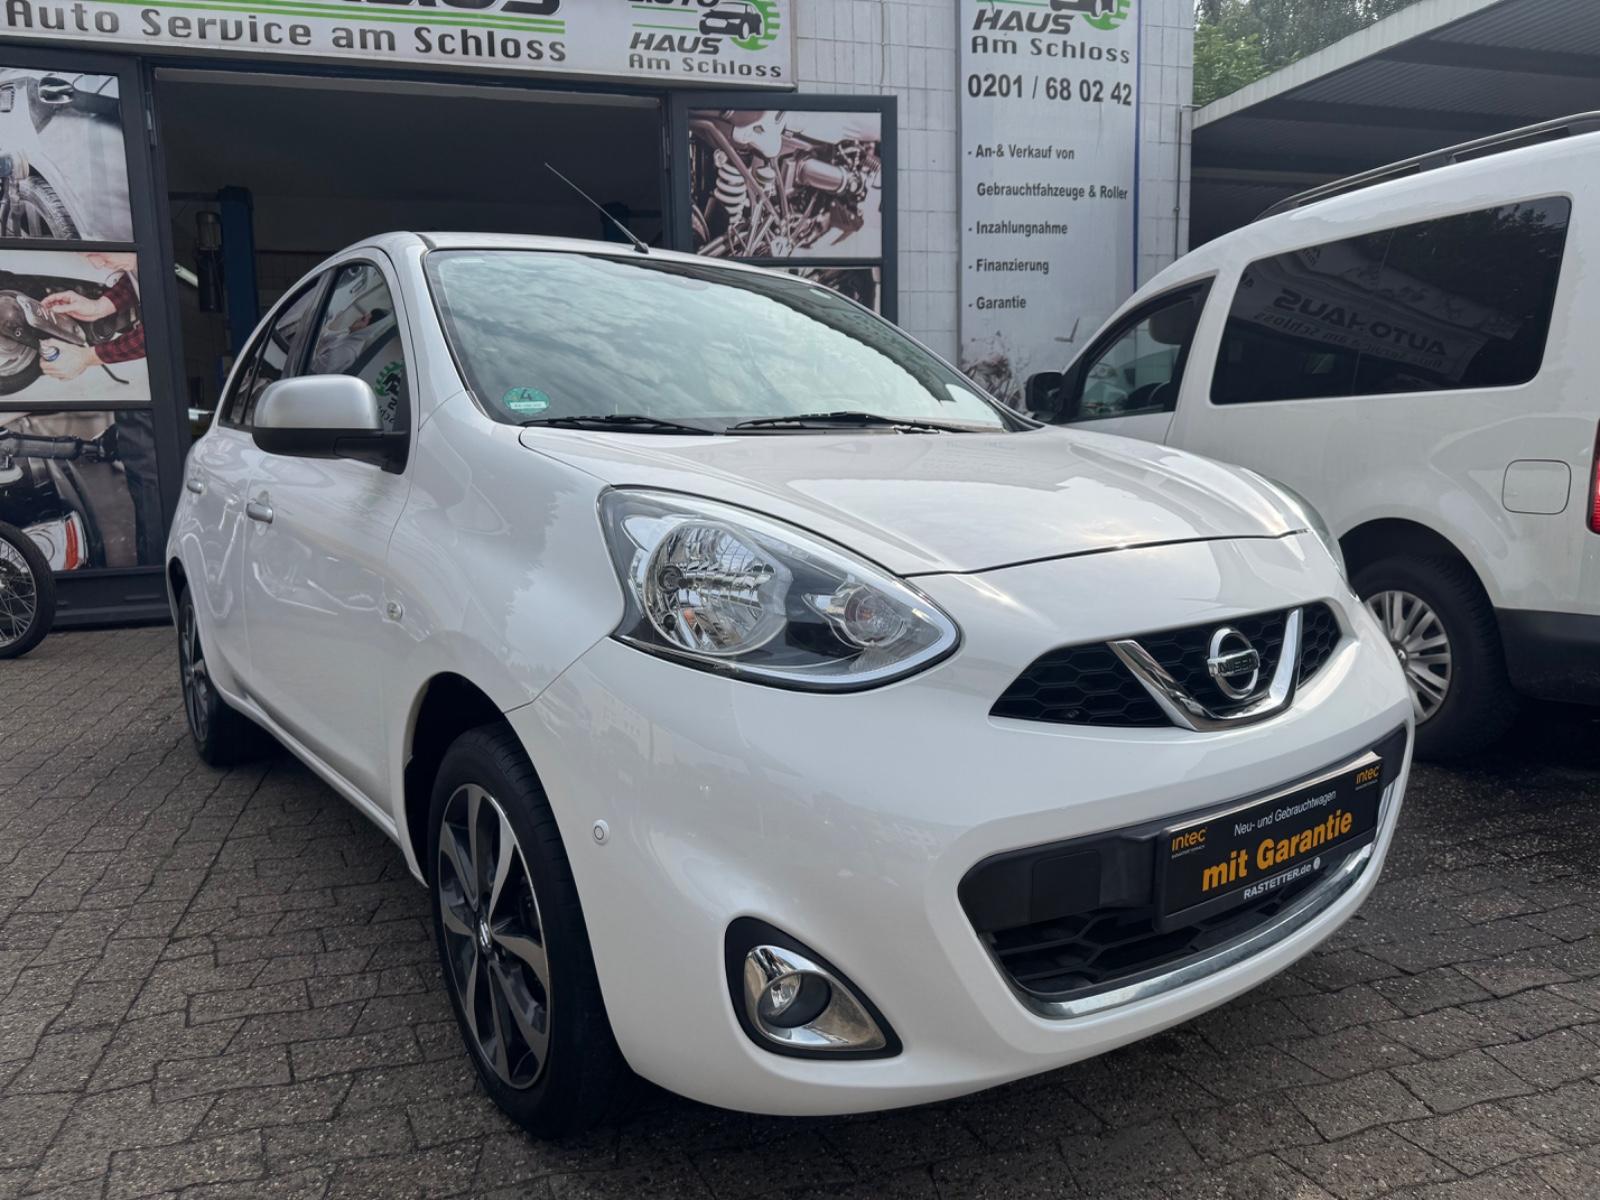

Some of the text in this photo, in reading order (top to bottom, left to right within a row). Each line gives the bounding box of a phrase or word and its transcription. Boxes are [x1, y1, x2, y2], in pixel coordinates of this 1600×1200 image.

[5, 0, 120, 33] Auto
[140, 8, 312, 46] Service
[331, 26, 396, 51] am
[414, 27, 566, 62] Schloss
[972, 9, 1075, 35] HAUS
[629, 32, 722, 55] HAUS
[971, 35, 1130, 64] Am Schloss
[629, 53, 782, 78] Am Schloss
[968, 73, 1023, 98] 0201
[1045, 77, 1071, 101] 68
[1079, 79, 1104, 102] 02
[1110, 82, 1132, 106] 42
[1009, 144, 1052, 159] Verkauf
[1055, 149, 1075, 160] von
[1088, 185, 1097, 198] &
[1100, 185, 1128, 200] Roller
[976, 220, 1068, 237] Inzahlungnahme
[976, 258, 1049, 275] Finanzierung
[976, 295, 1026, 310] Garantie
[1234, 790, 1336, 836] Neu- und Gebrauchtwagen
[1202, 809, 1353, 891] mit Garantie
[1243, 864, 1311, 899] RASTETTER.de
